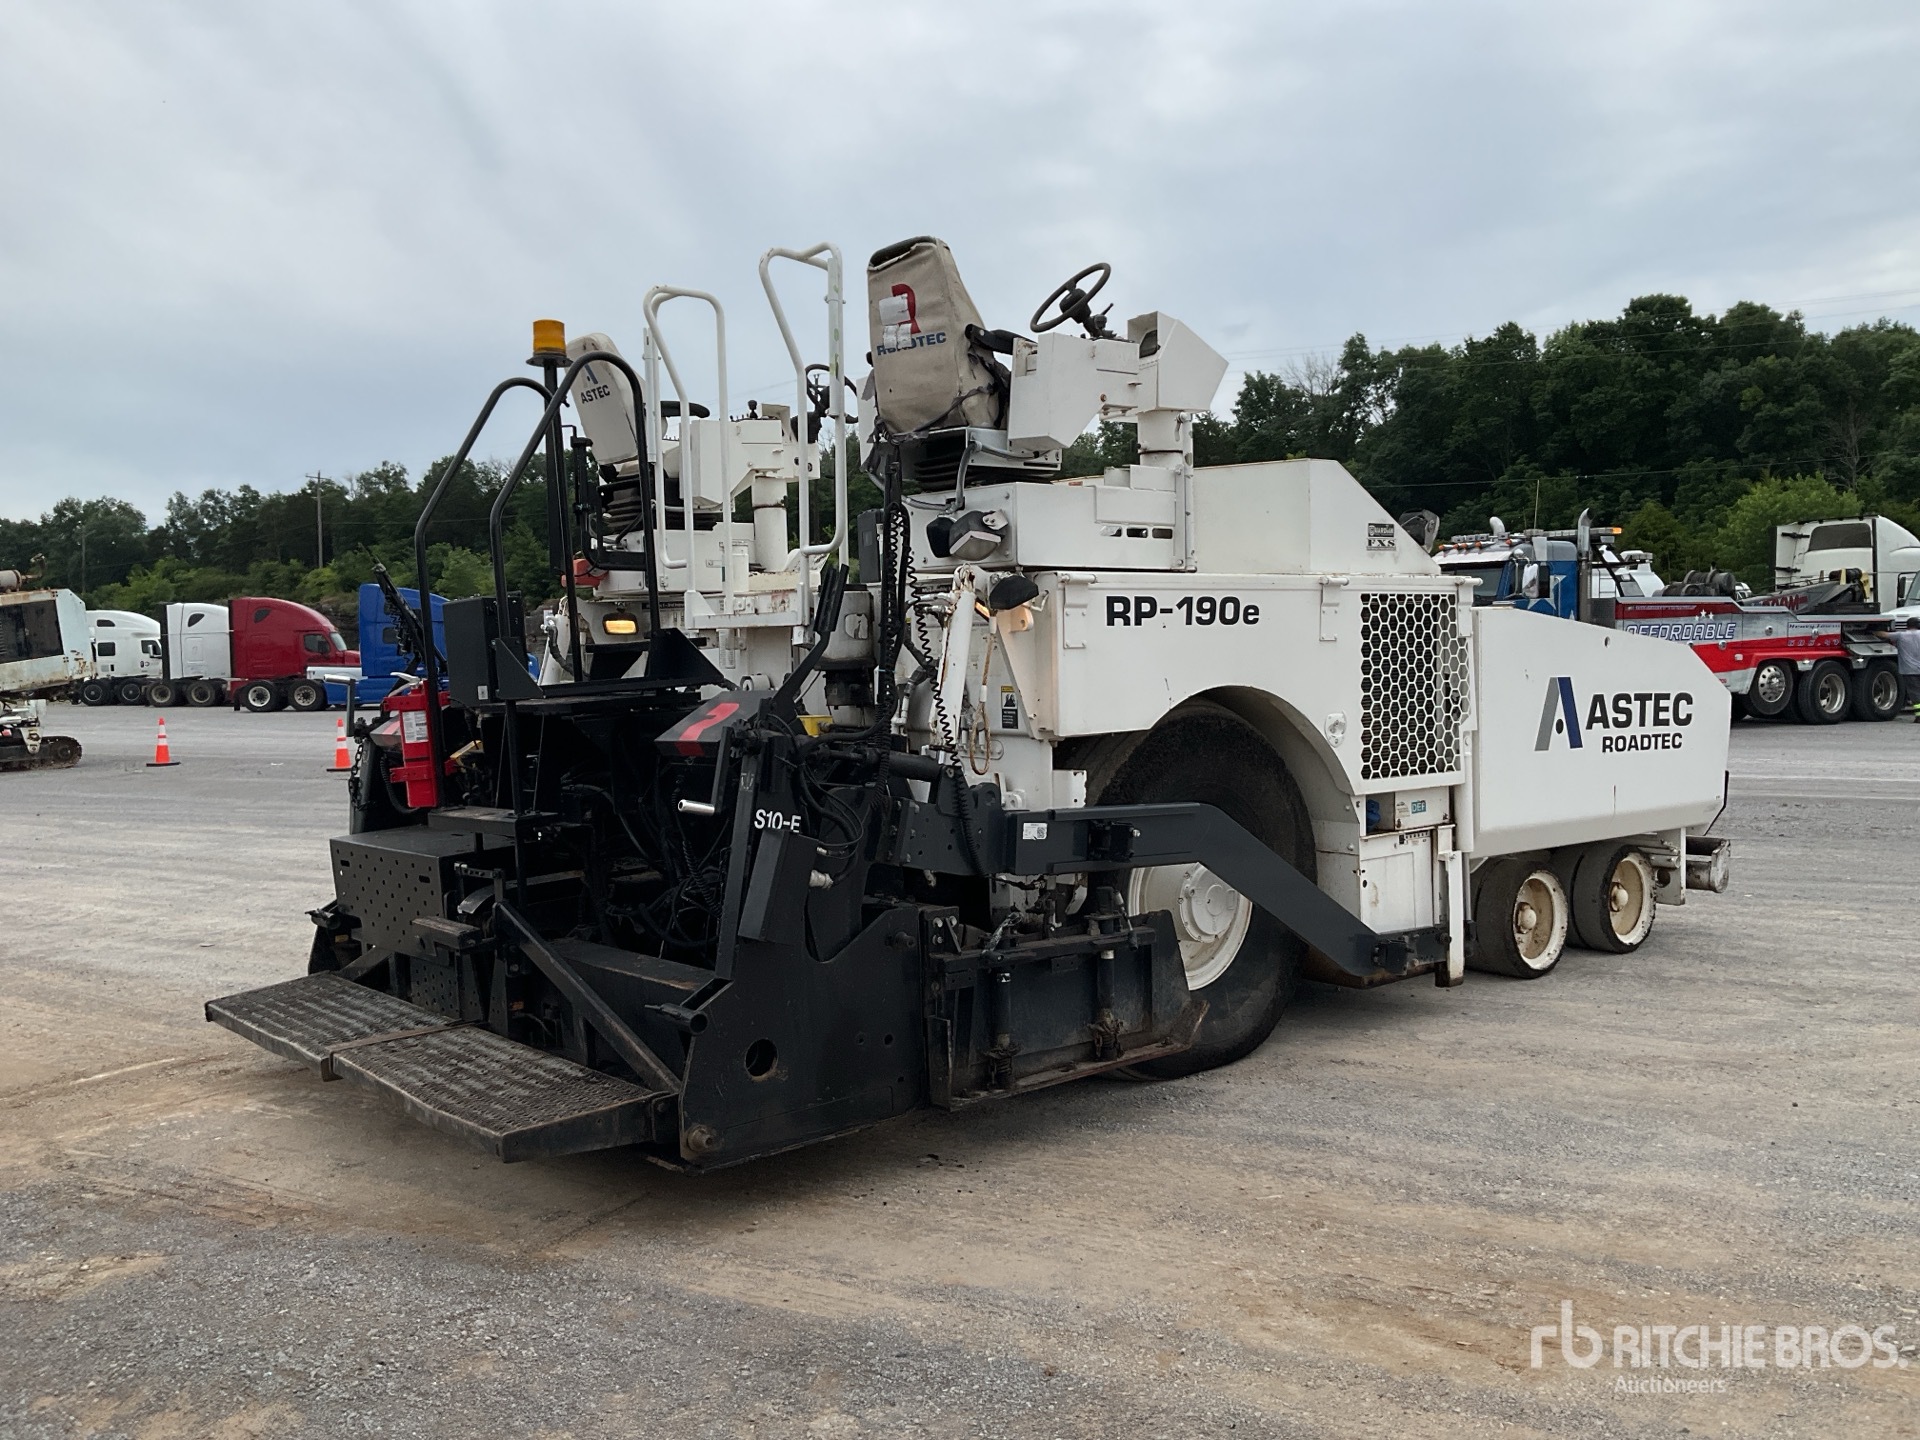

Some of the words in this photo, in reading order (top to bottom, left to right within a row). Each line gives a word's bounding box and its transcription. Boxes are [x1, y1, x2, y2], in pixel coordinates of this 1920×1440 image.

[580, 384, 611, 404] ASTEC
[1106, 595, 1260, 626] RP-190e
[1585, 692, 1694, 730] ASTEC
[1602, 732, 1683, 753] ROADTEC
[754, 808, 802, 833] S10-E
